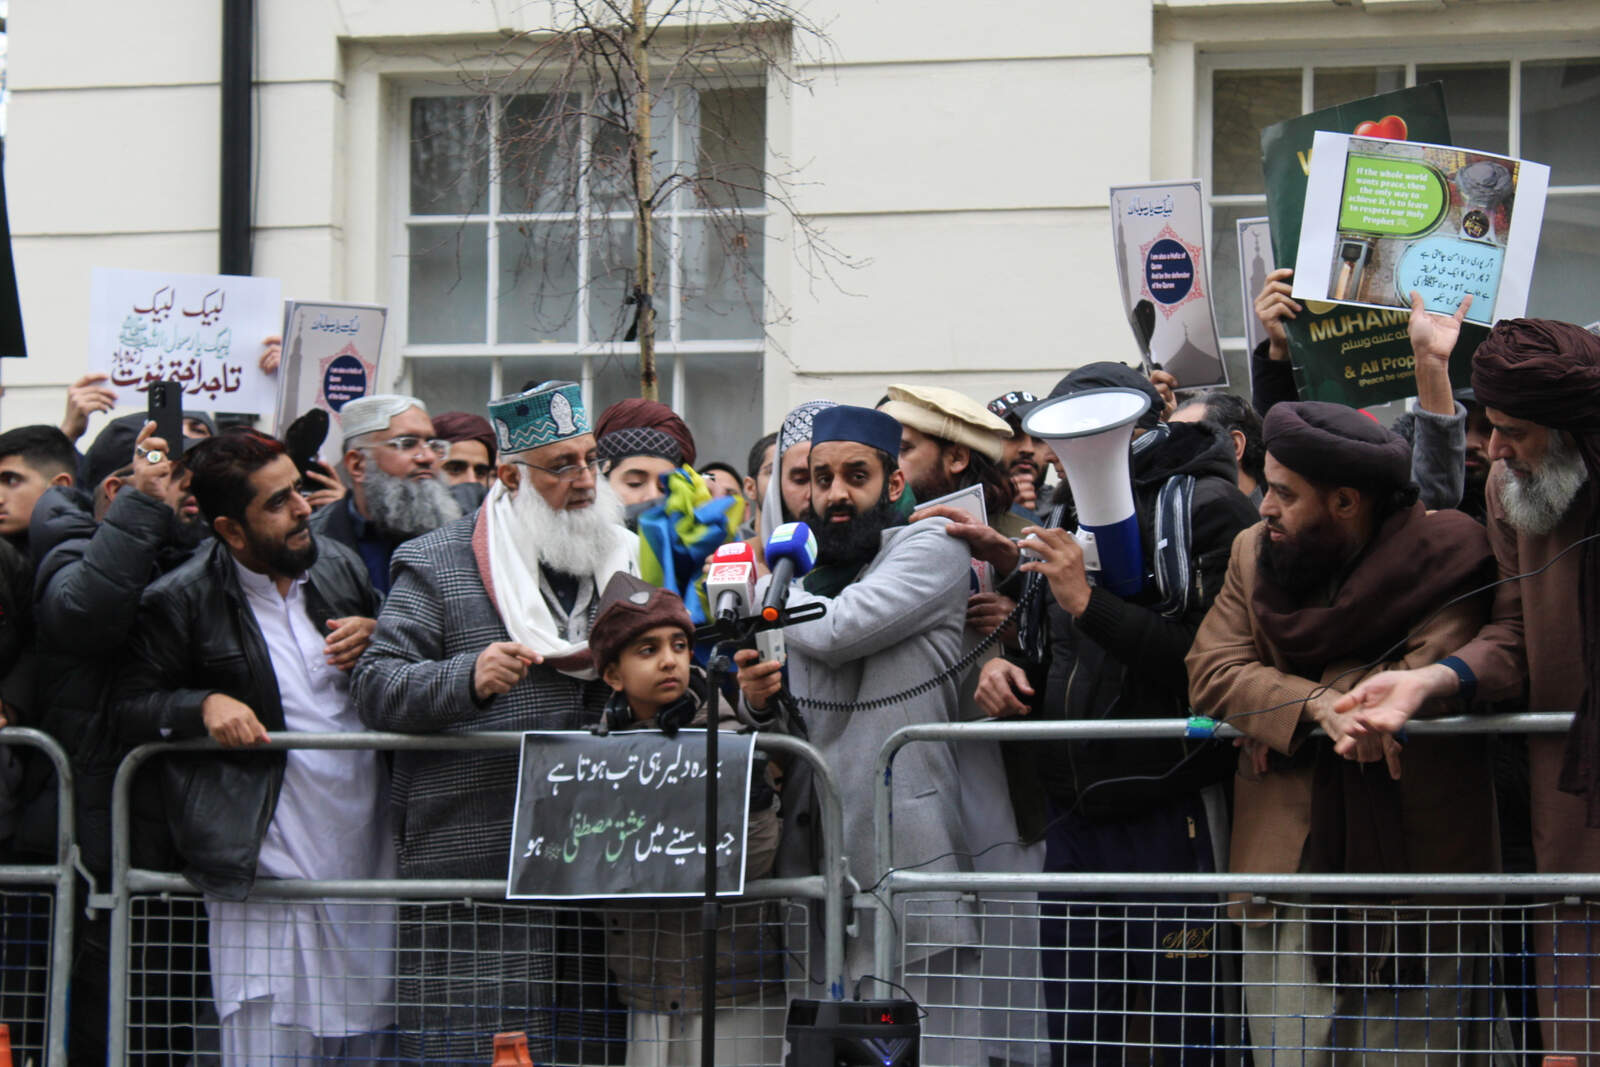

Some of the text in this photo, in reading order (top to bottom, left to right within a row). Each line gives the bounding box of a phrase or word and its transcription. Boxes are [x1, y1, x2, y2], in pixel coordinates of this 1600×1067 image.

[1364, 168, 1378, 177] the
[1380, 169, 1403, 179] whole
[1405, 173, 1429, 182] world
[1356, 177, 1379, 185] wants
[1407, 181, 1427, 191] then
[1360, 186, 1420, 200] the only way to
[1348, 194, 1377, 204] achieve
[1397, 200, 1406, 208] to
[1407, 200, 1429, 210] learn
[1349, 204, 1425, 220] to respect our Holy
[1363, 215, 1395, 226] Prophet
[1343, 355, 1416, 379] & All Prop
